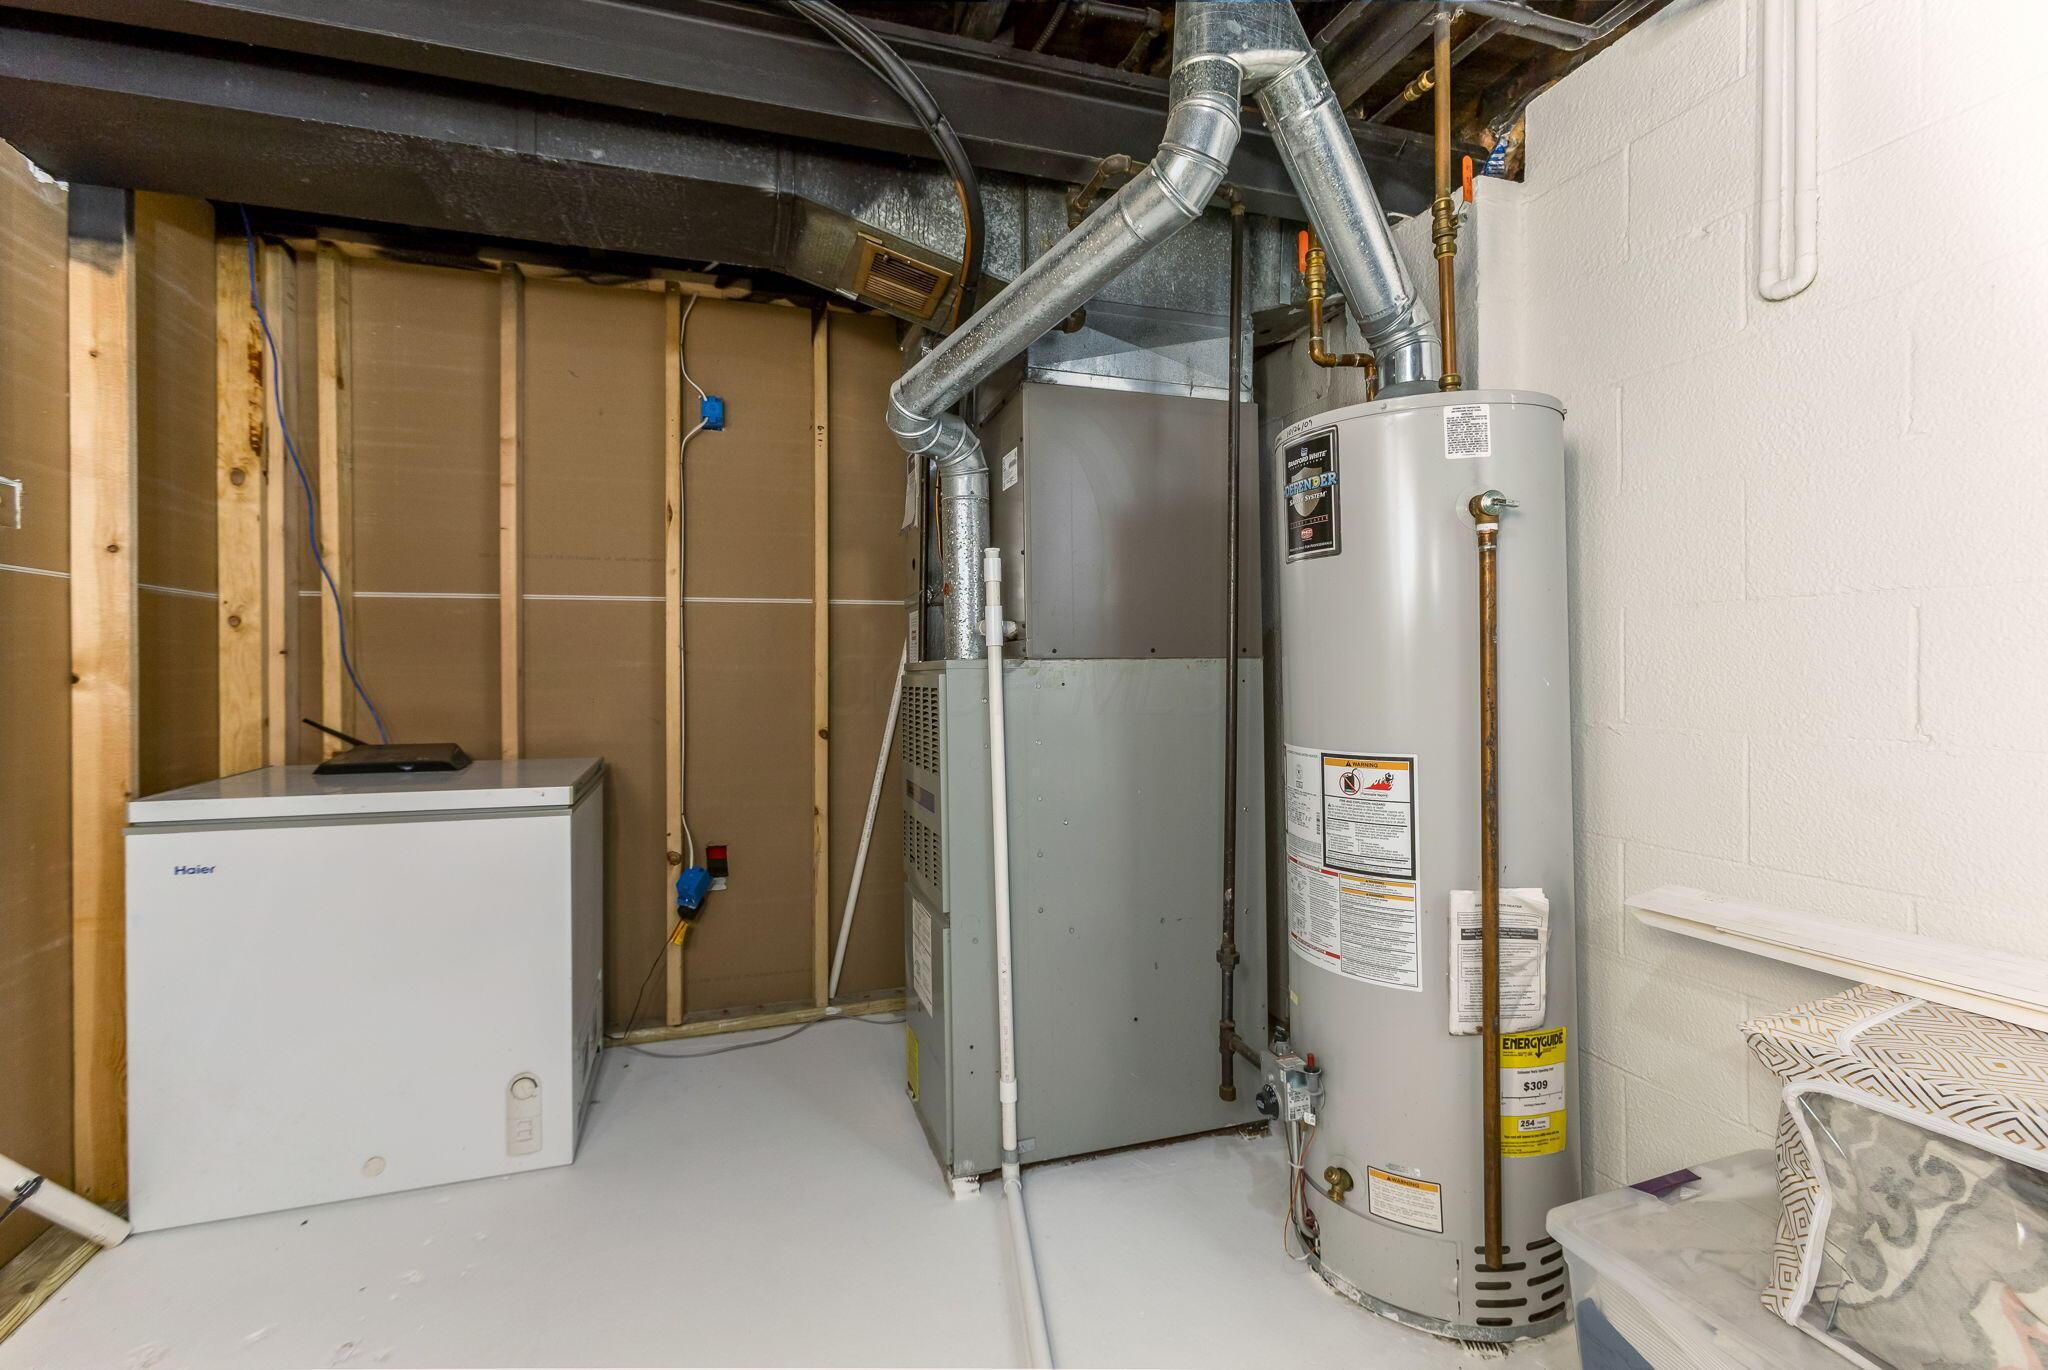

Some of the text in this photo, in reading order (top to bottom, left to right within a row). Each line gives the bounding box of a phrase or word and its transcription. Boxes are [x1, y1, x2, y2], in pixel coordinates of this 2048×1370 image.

[1288, 455, 1309, 468] BRADFORD
[1308, 450, 1327, 460] WHITE
[1284, 471, 1338, 498] DEFENDER
[1304, 491, 1327, 502] SYSTEM
[1352, 761, 1379, 769] WARNING
[173, 864, 216, 876] Haier
[1502, 1031, 1563, 1051] ENERGYGUIDE
[1523, 1079, 1548, 1092] $309
[1520, 1119, 1536, 1128] 254
[1391, 1176, 1420, 1189] WARNING
